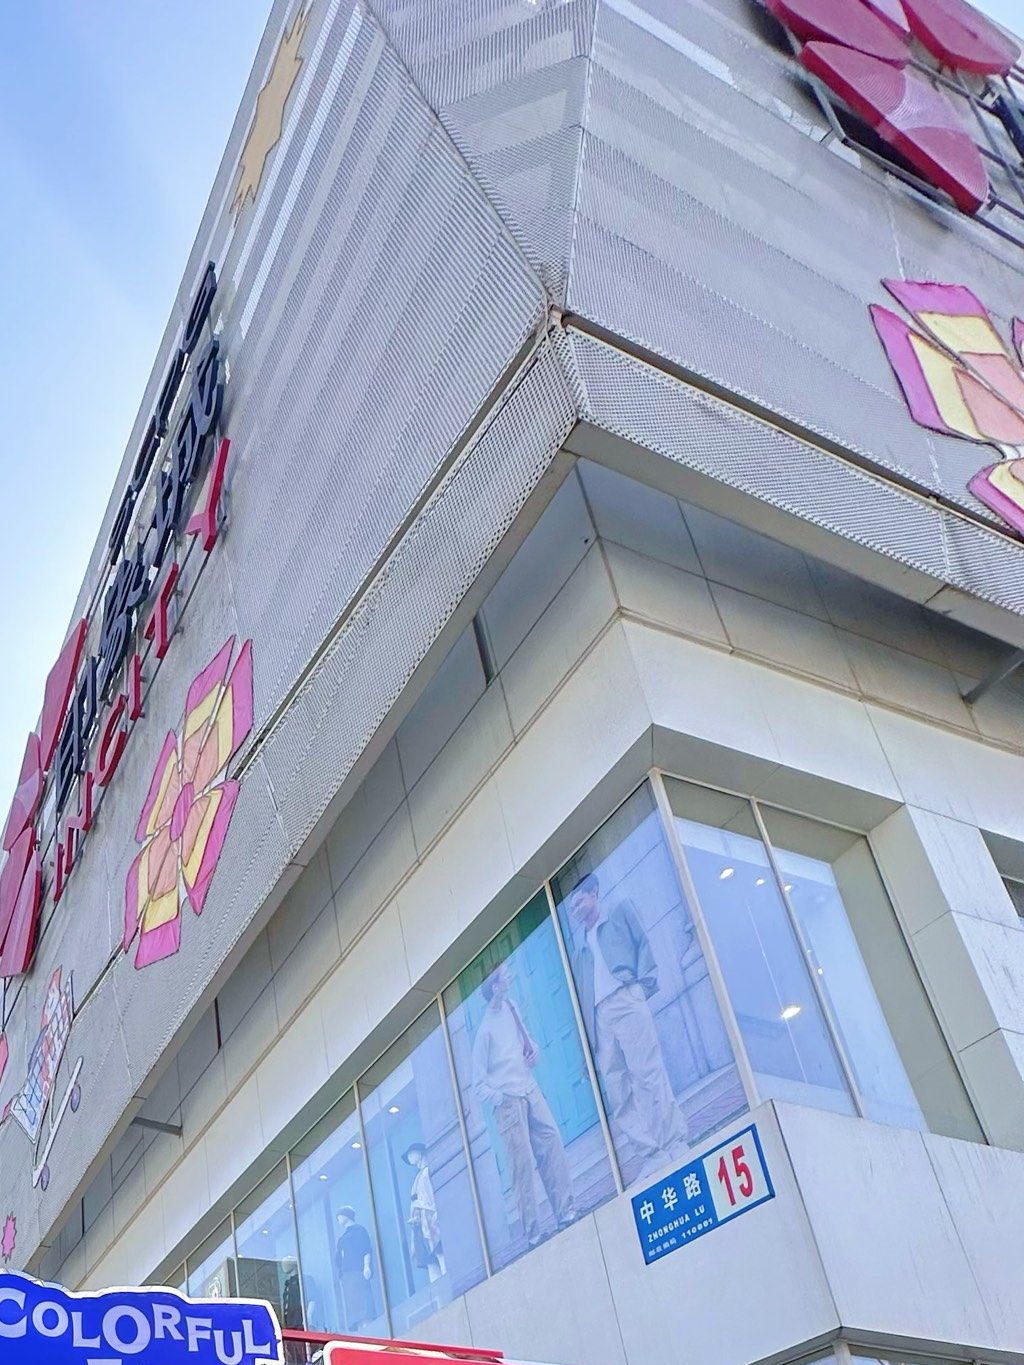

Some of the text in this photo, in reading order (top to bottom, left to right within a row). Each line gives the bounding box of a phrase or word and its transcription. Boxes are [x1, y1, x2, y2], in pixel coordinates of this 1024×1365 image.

[55, 336, 224, 814] 印象城
[54, 436, 231, 902] INCITY
[639, 1173, 702, 1225] 中华路
[718, 1145, 753, 1206] 15
[647, 1204, 706, 1243] ZHONGHUA LU
[681, 1217, 713, 1239] 110001
